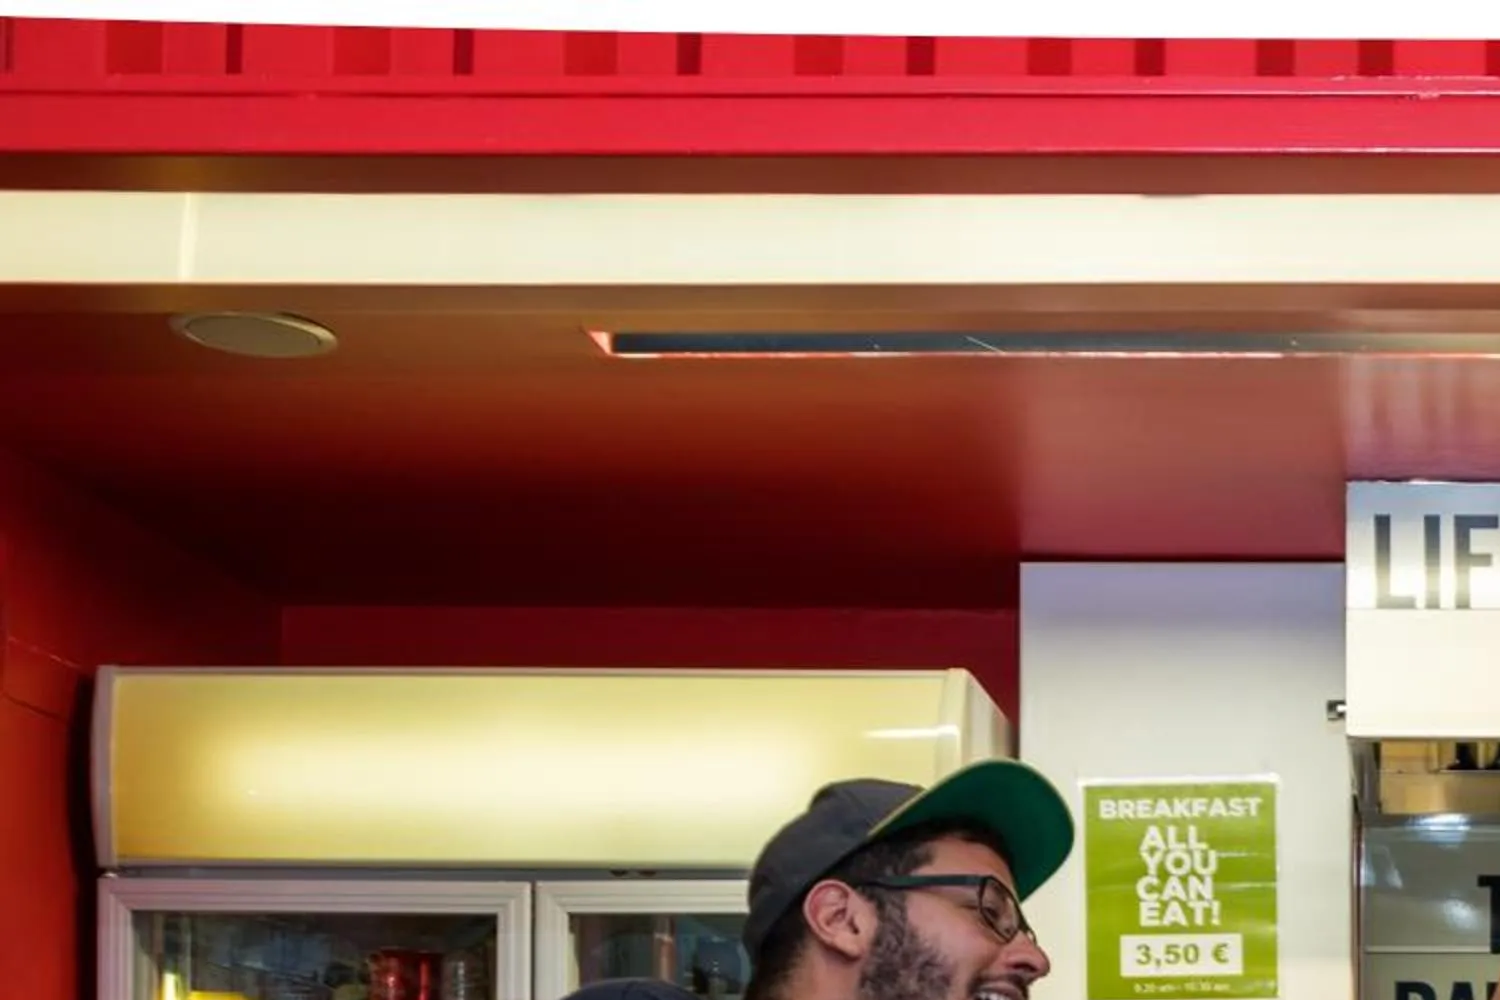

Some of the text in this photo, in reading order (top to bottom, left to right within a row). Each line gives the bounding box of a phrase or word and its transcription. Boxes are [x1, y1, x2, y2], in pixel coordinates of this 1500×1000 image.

[1099, 796, 1262, 820] BREAKFAST
[1139, 824, 1209, 851] ALL
[1138, 849, 1218, 876] YOU
[1135, 875, 1214, 902] CAN
[1139, 900, 1221, 927] EAT!
[1135, 942, 1230, 968] 3,50 €
